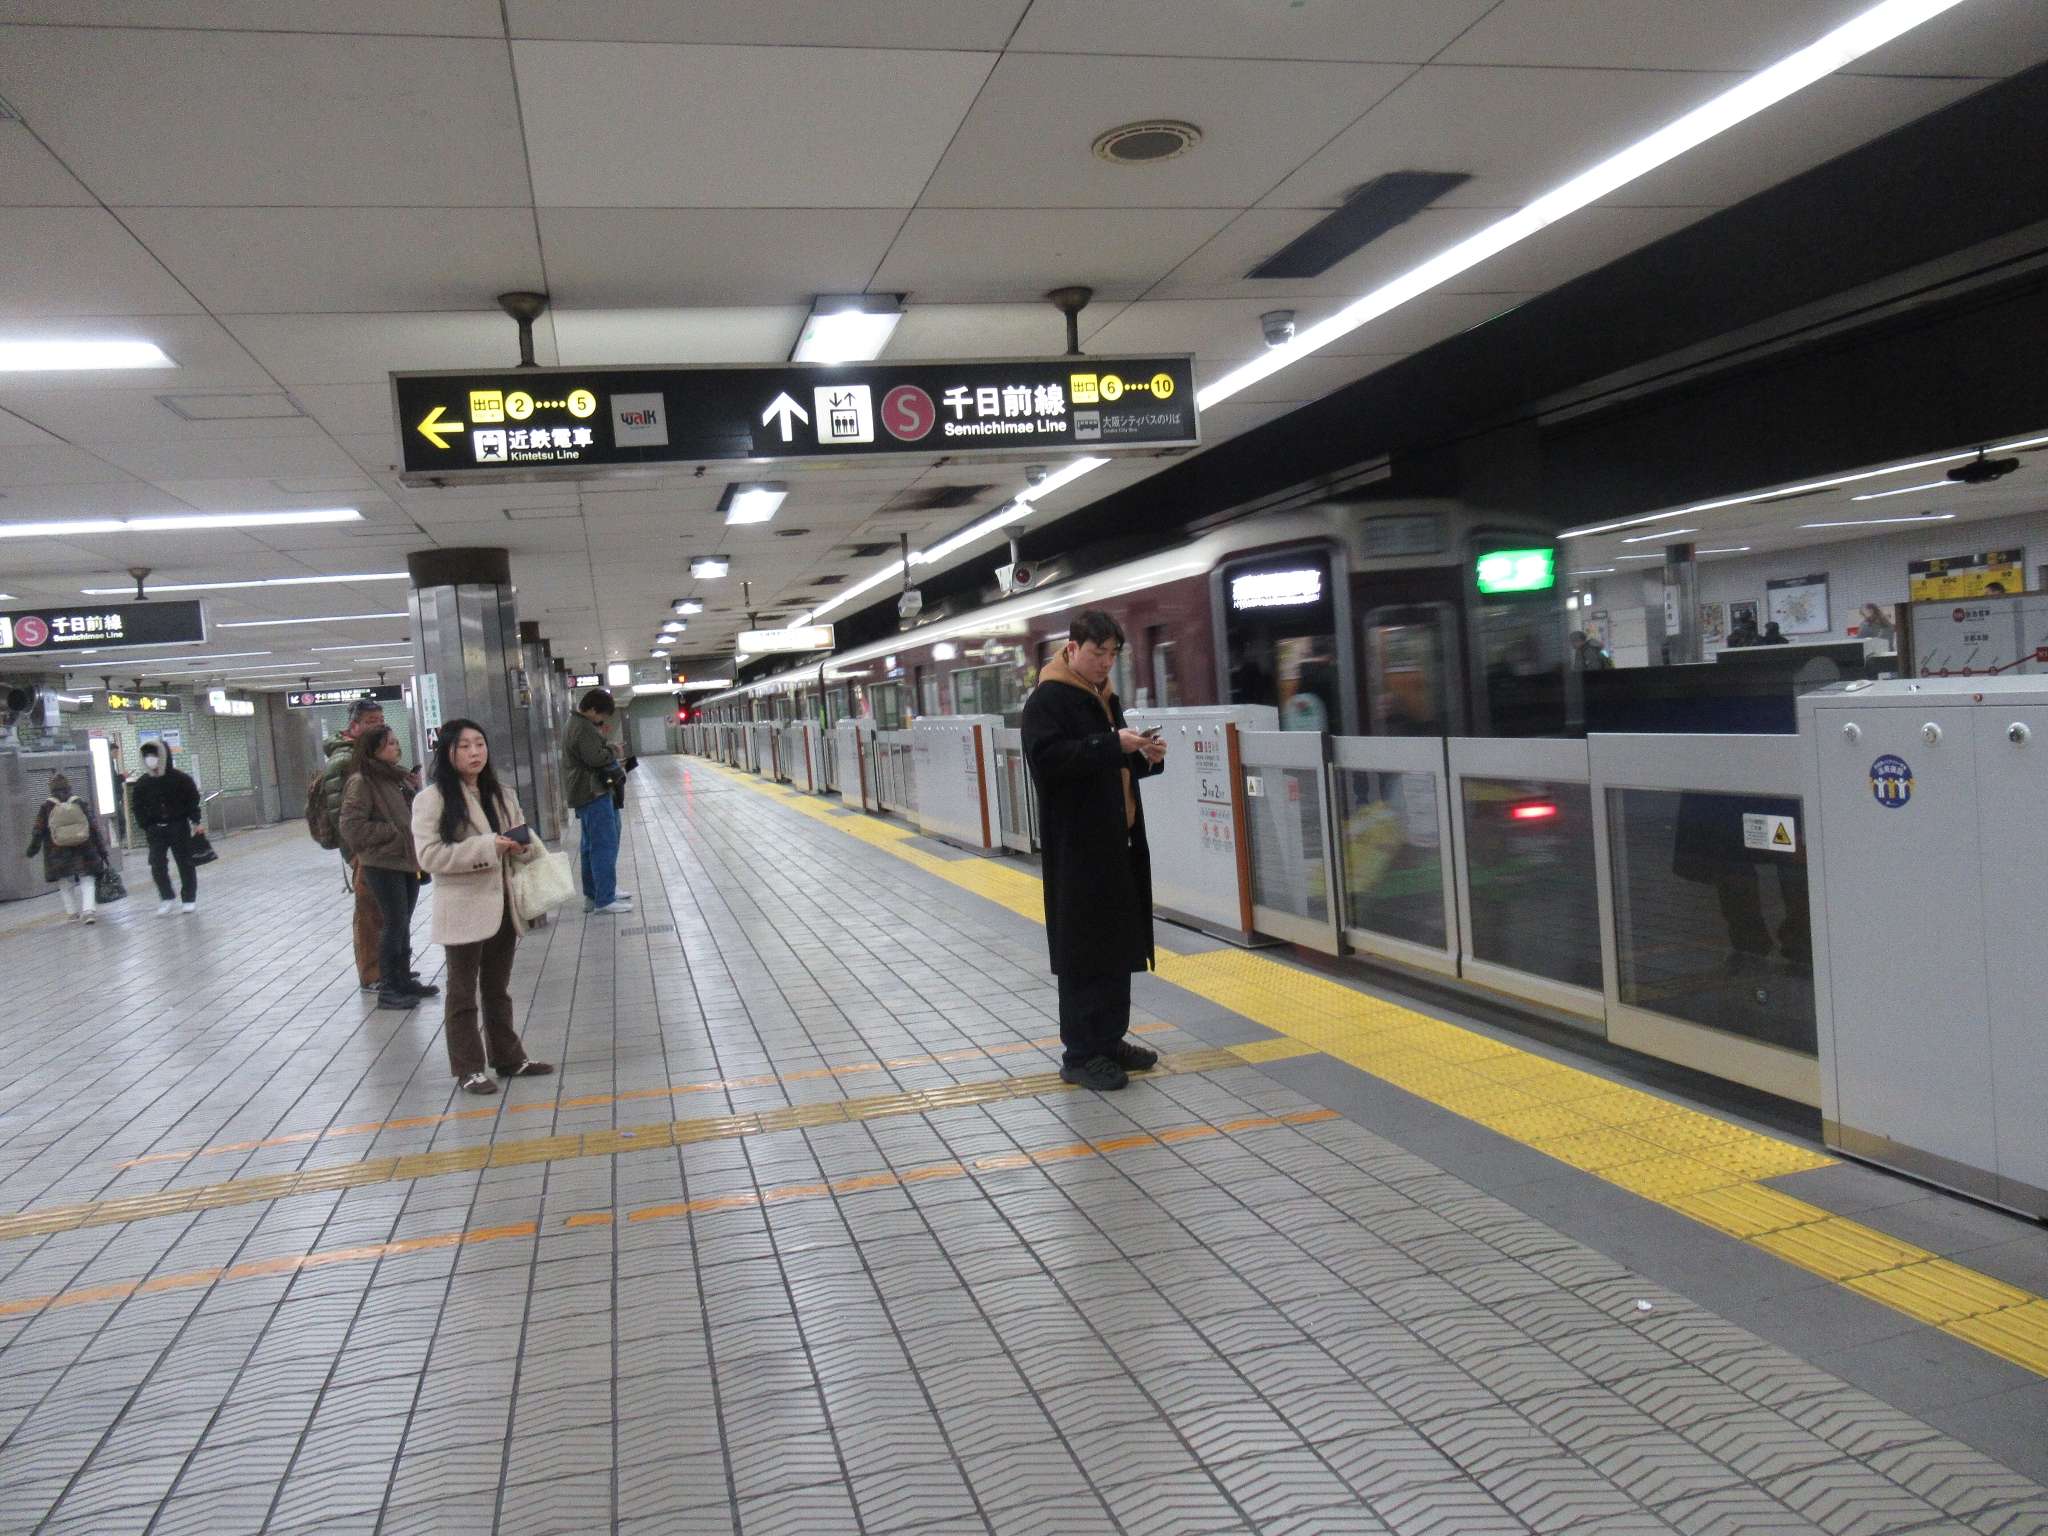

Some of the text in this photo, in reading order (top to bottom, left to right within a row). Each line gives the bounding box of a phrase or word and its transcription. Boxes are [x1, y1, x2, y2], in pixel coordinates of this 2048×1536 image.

[1073, 379, 1171, 394] 出口 6 10
[473, 397, 587, 413] 出口 2 5
[942, 383, 1066, 419] 千日前線
[896, 394, 920, 432] S
[1102, 413, 1181, 429] 大阪シティバスのりば
[944, 418, 1067, 438] Sennichimae Line
[508, 426, 594, 451] 近鉄電車
[510, 449, 580, 462] Kintetsu Line
[23, 621, 39, 642] S
[52, 614, 123, 634] 千日前線
[105, 631, 124, 640] Line
